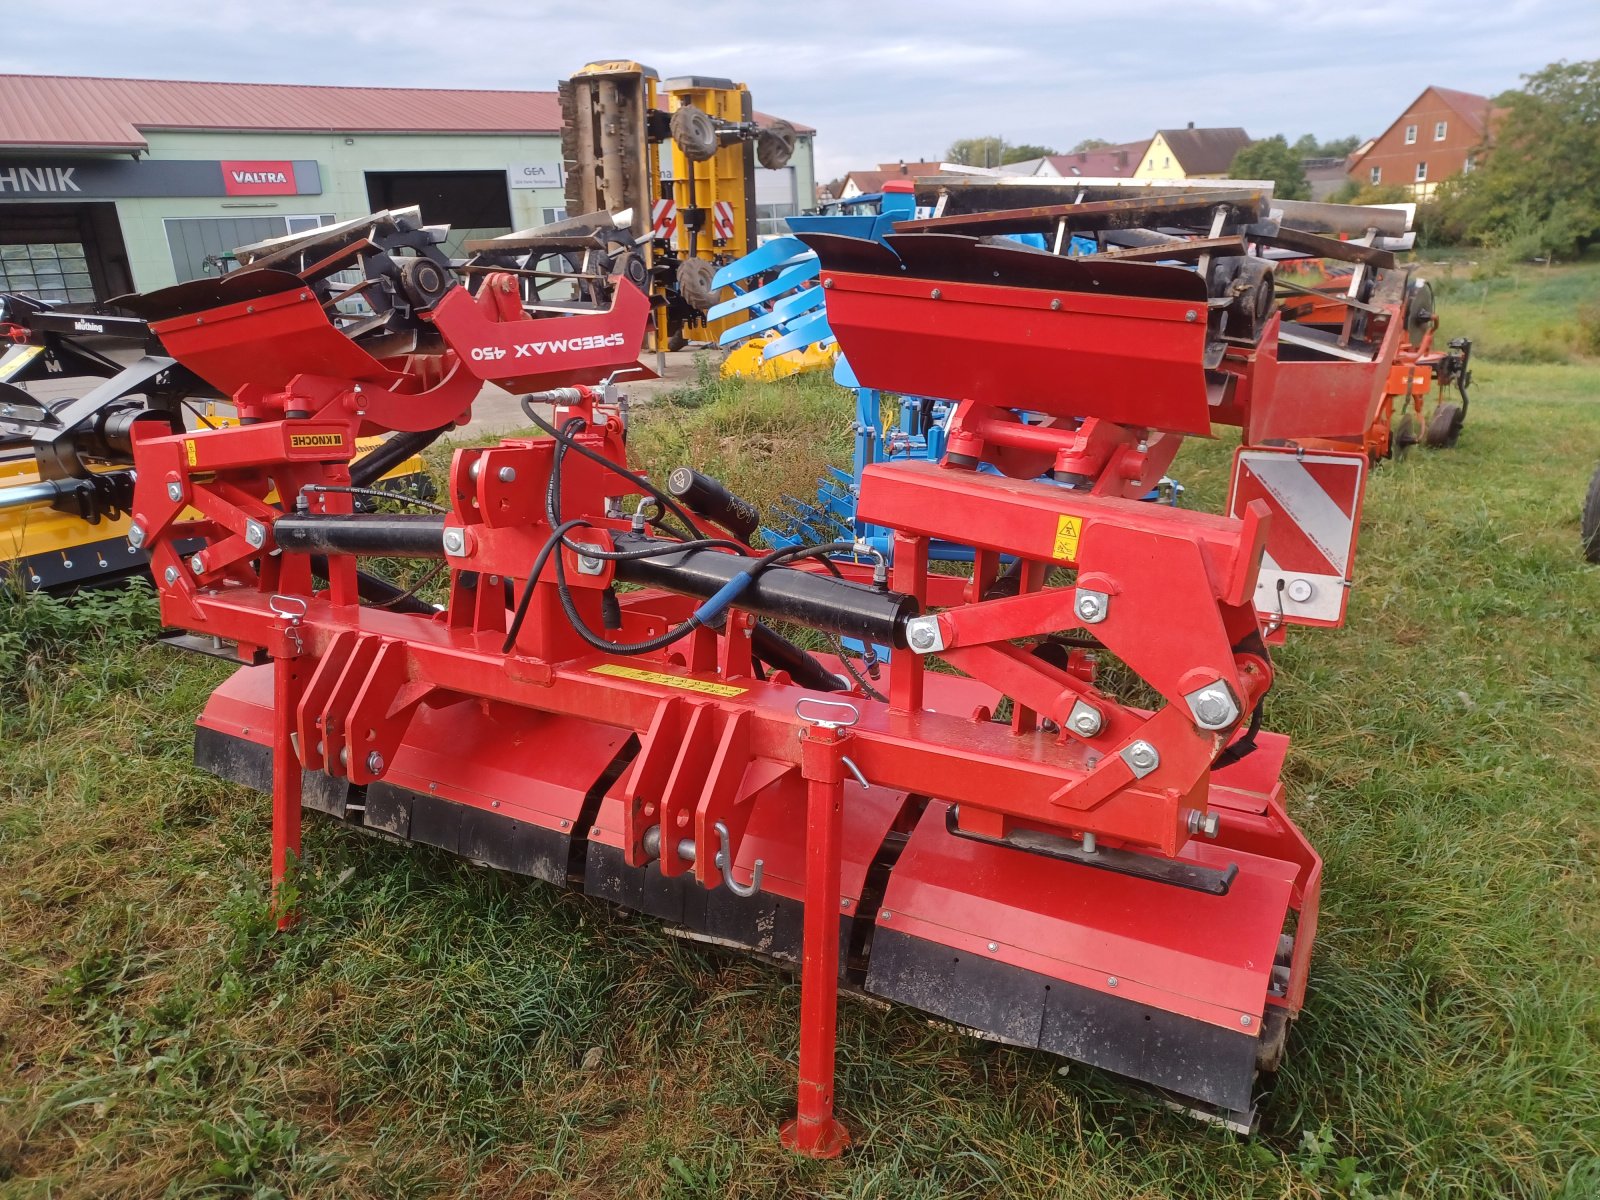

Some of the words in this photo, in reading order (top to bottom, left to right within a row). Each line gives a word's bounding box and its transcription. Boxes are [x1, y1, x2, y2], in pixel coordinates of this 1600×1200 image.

[231, 170, 287, 184] VALTRA
[523, 167, 546, 176] GEA
[513, 332, 625, 358] SPEEDMAX
[470, 346, 507, 361] 450
[292, 435, 333, 446] KNOCHE
